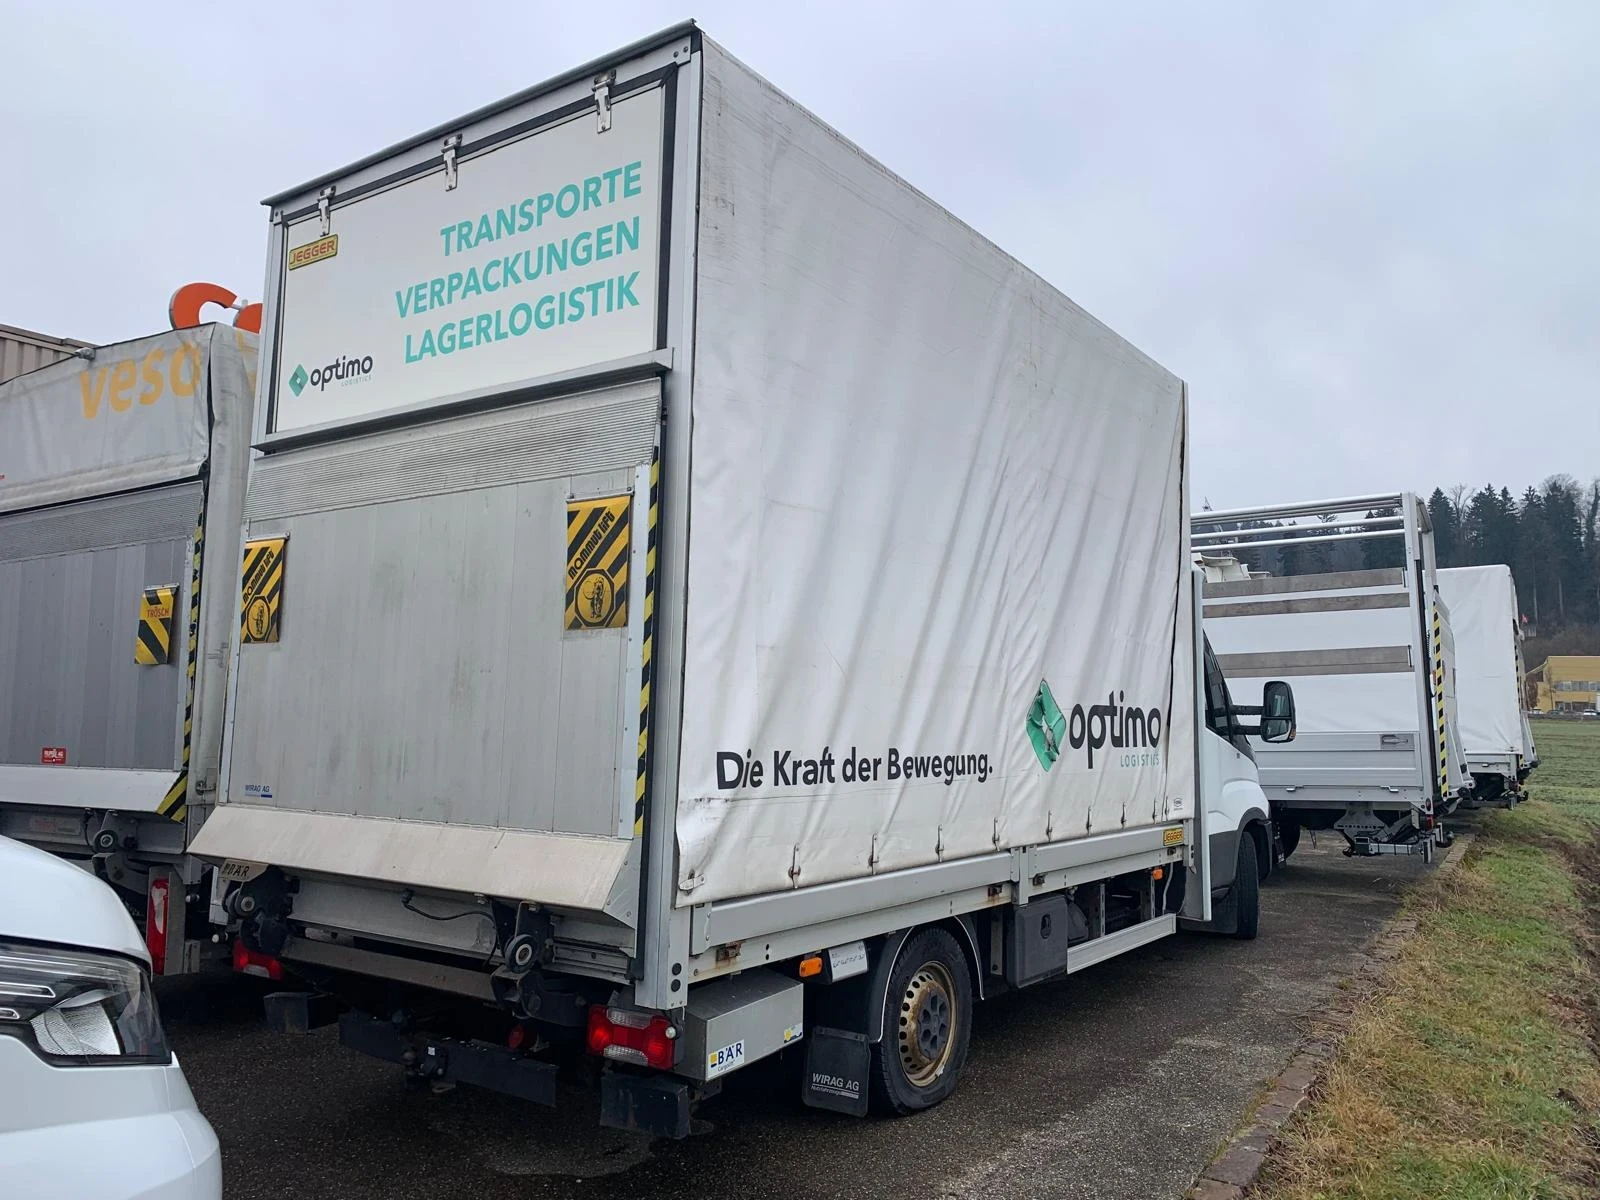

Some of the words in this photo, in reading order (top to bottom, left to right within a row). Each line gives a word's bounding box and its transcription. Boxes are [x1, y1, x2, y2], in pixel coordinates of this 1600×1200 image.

[440, 160, 642, 256] TRANSPORTE
[289, 239, 335, 265] JEGGER
[395, 216, 640, 318] VERPACKUNGEN
[405, 271, 641, 364] LAGERLOGISTIK
[310, 355, 373, 392] optimo
[1069, 690, 1161, 770] optimo
[716, 748, 764, 790] Die
[773, 746, 836, 787] Kraft
[842, 746, 882, 783] der
[887, 747, 994, 786] Bewegung.
[1120, 754, 1160, 768] LOGISTICS
[718, 1042, 743, 1066] BÄR
[812, 1072, 844, 1088] WIRAG
[845, 1080, 860, 1091] AG
